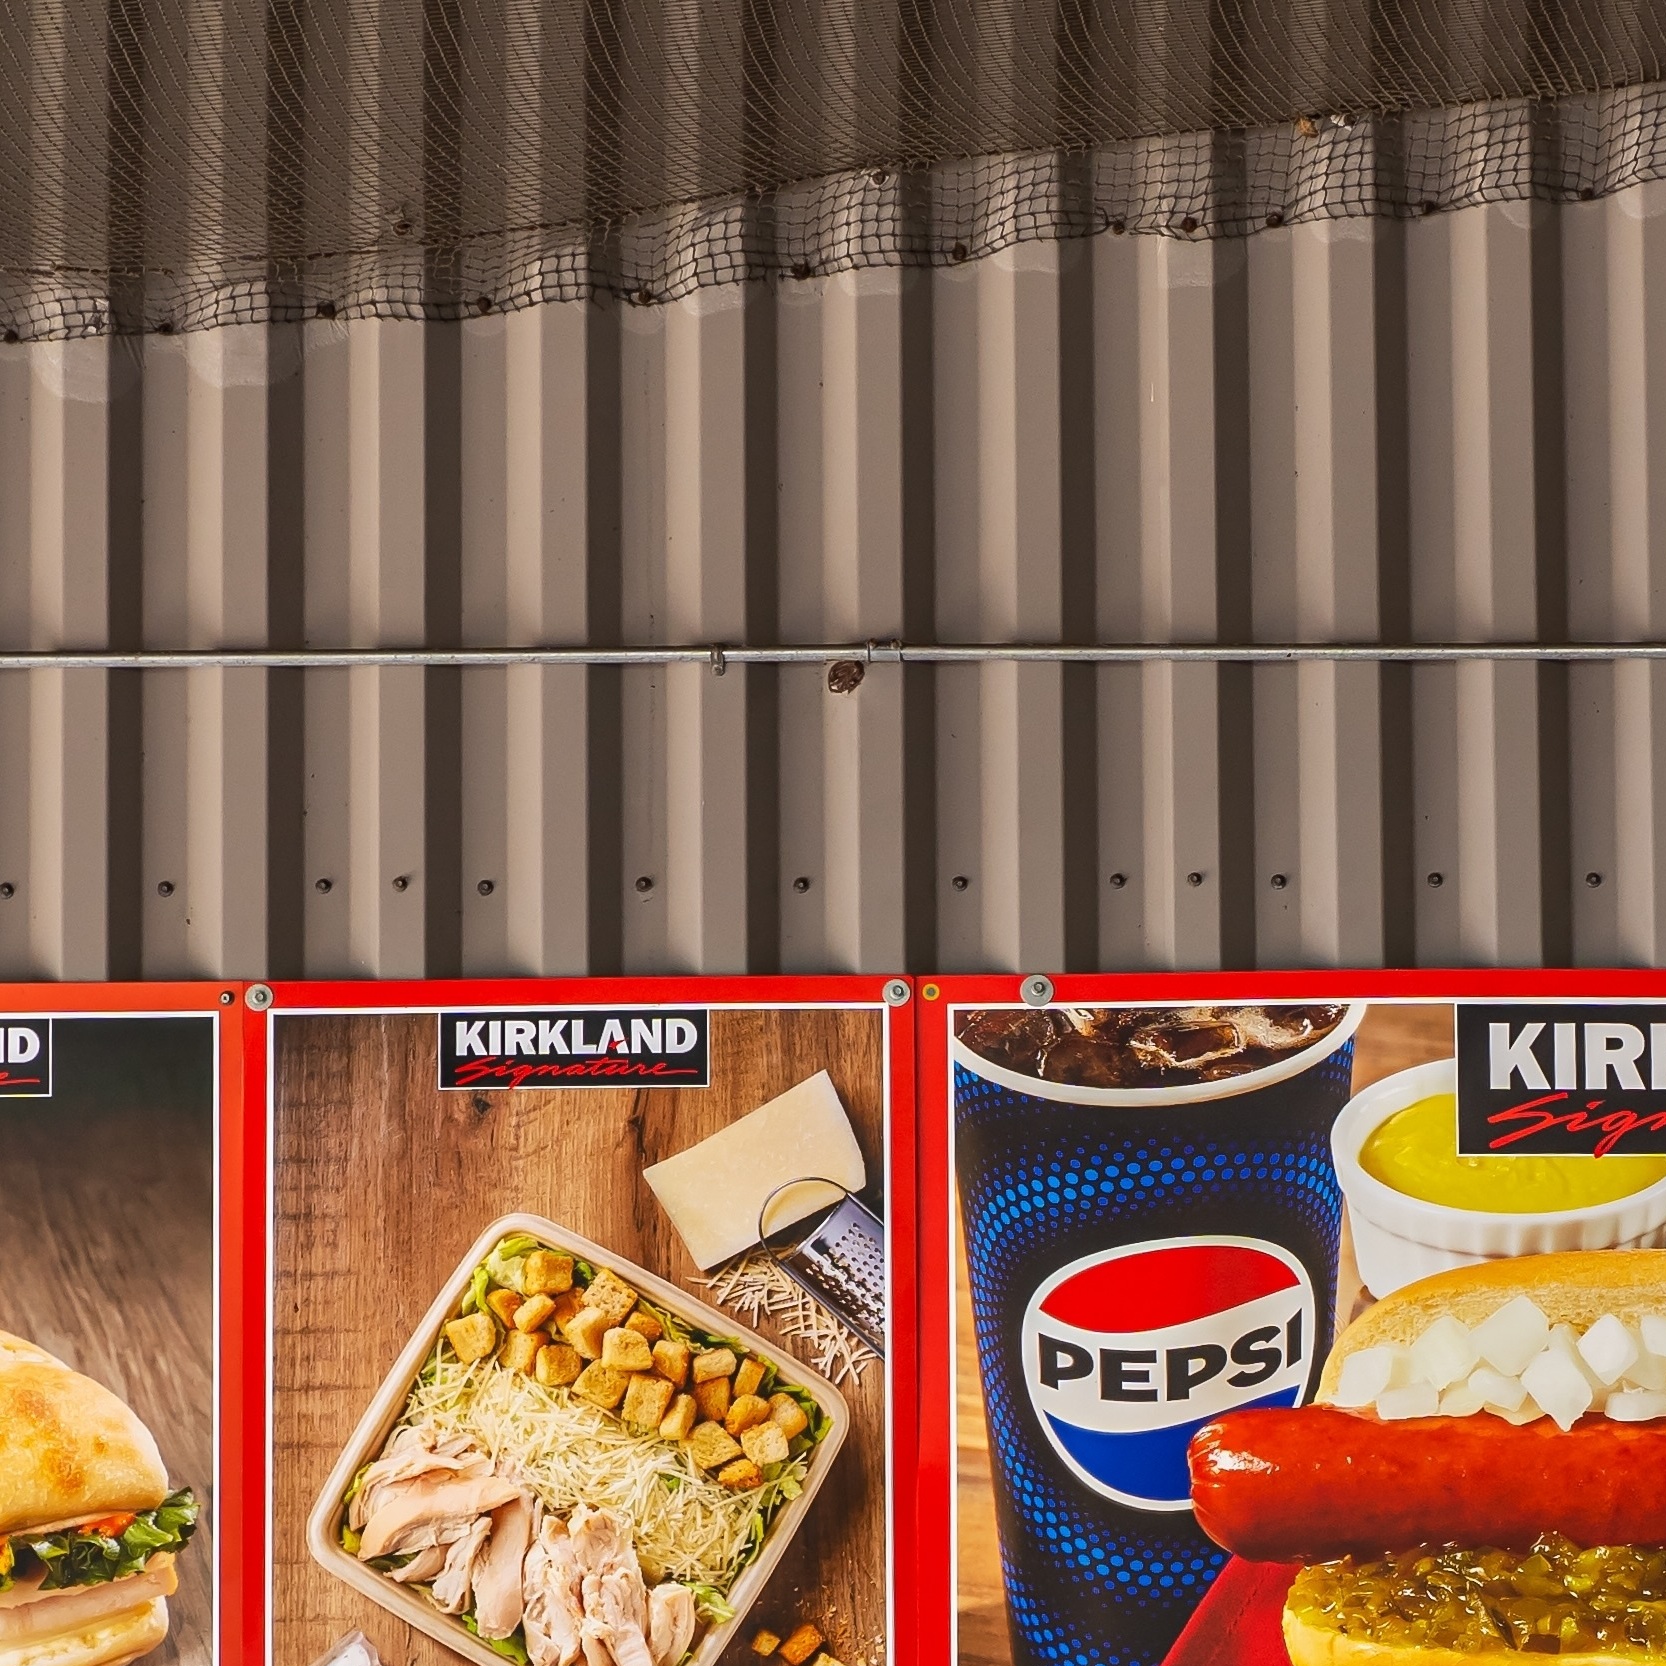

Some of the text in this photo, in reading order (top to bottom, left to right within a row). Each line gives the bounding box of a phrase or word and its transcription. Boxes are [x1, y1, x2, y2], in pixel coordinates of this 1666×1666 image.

[456, 1019, 698, 1056] KIRKLAND
[455, 1056, 698, 1090] Signature
[1038, 1307, 1302, 1402] PEPSI
